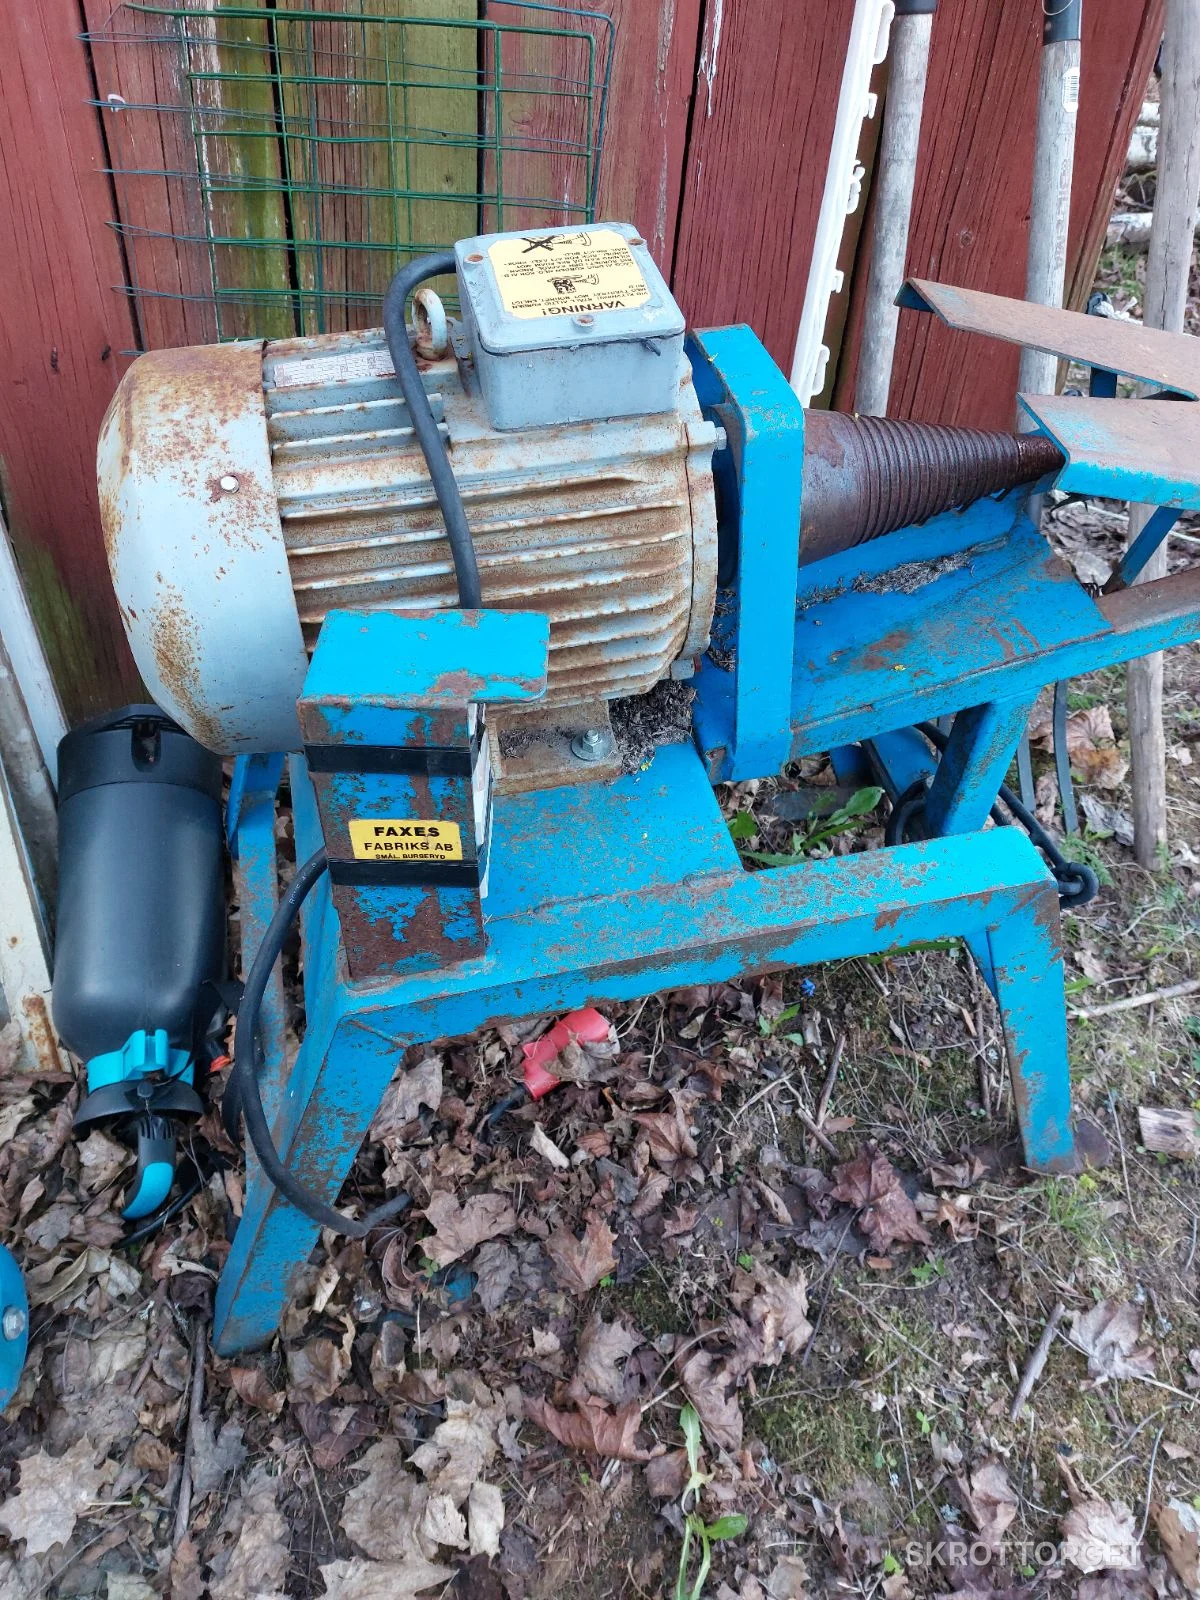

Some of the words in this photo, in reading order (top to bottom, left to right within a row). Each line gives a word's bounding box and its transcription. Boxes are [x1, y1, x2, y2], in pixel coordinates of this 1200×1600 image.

[540, 300, 625, 315] VARNING!
[374, 826, 440, 837] FAXES
[364, 842, 430, 851] FABRIKS
[434, 843, 454, 852] AB
